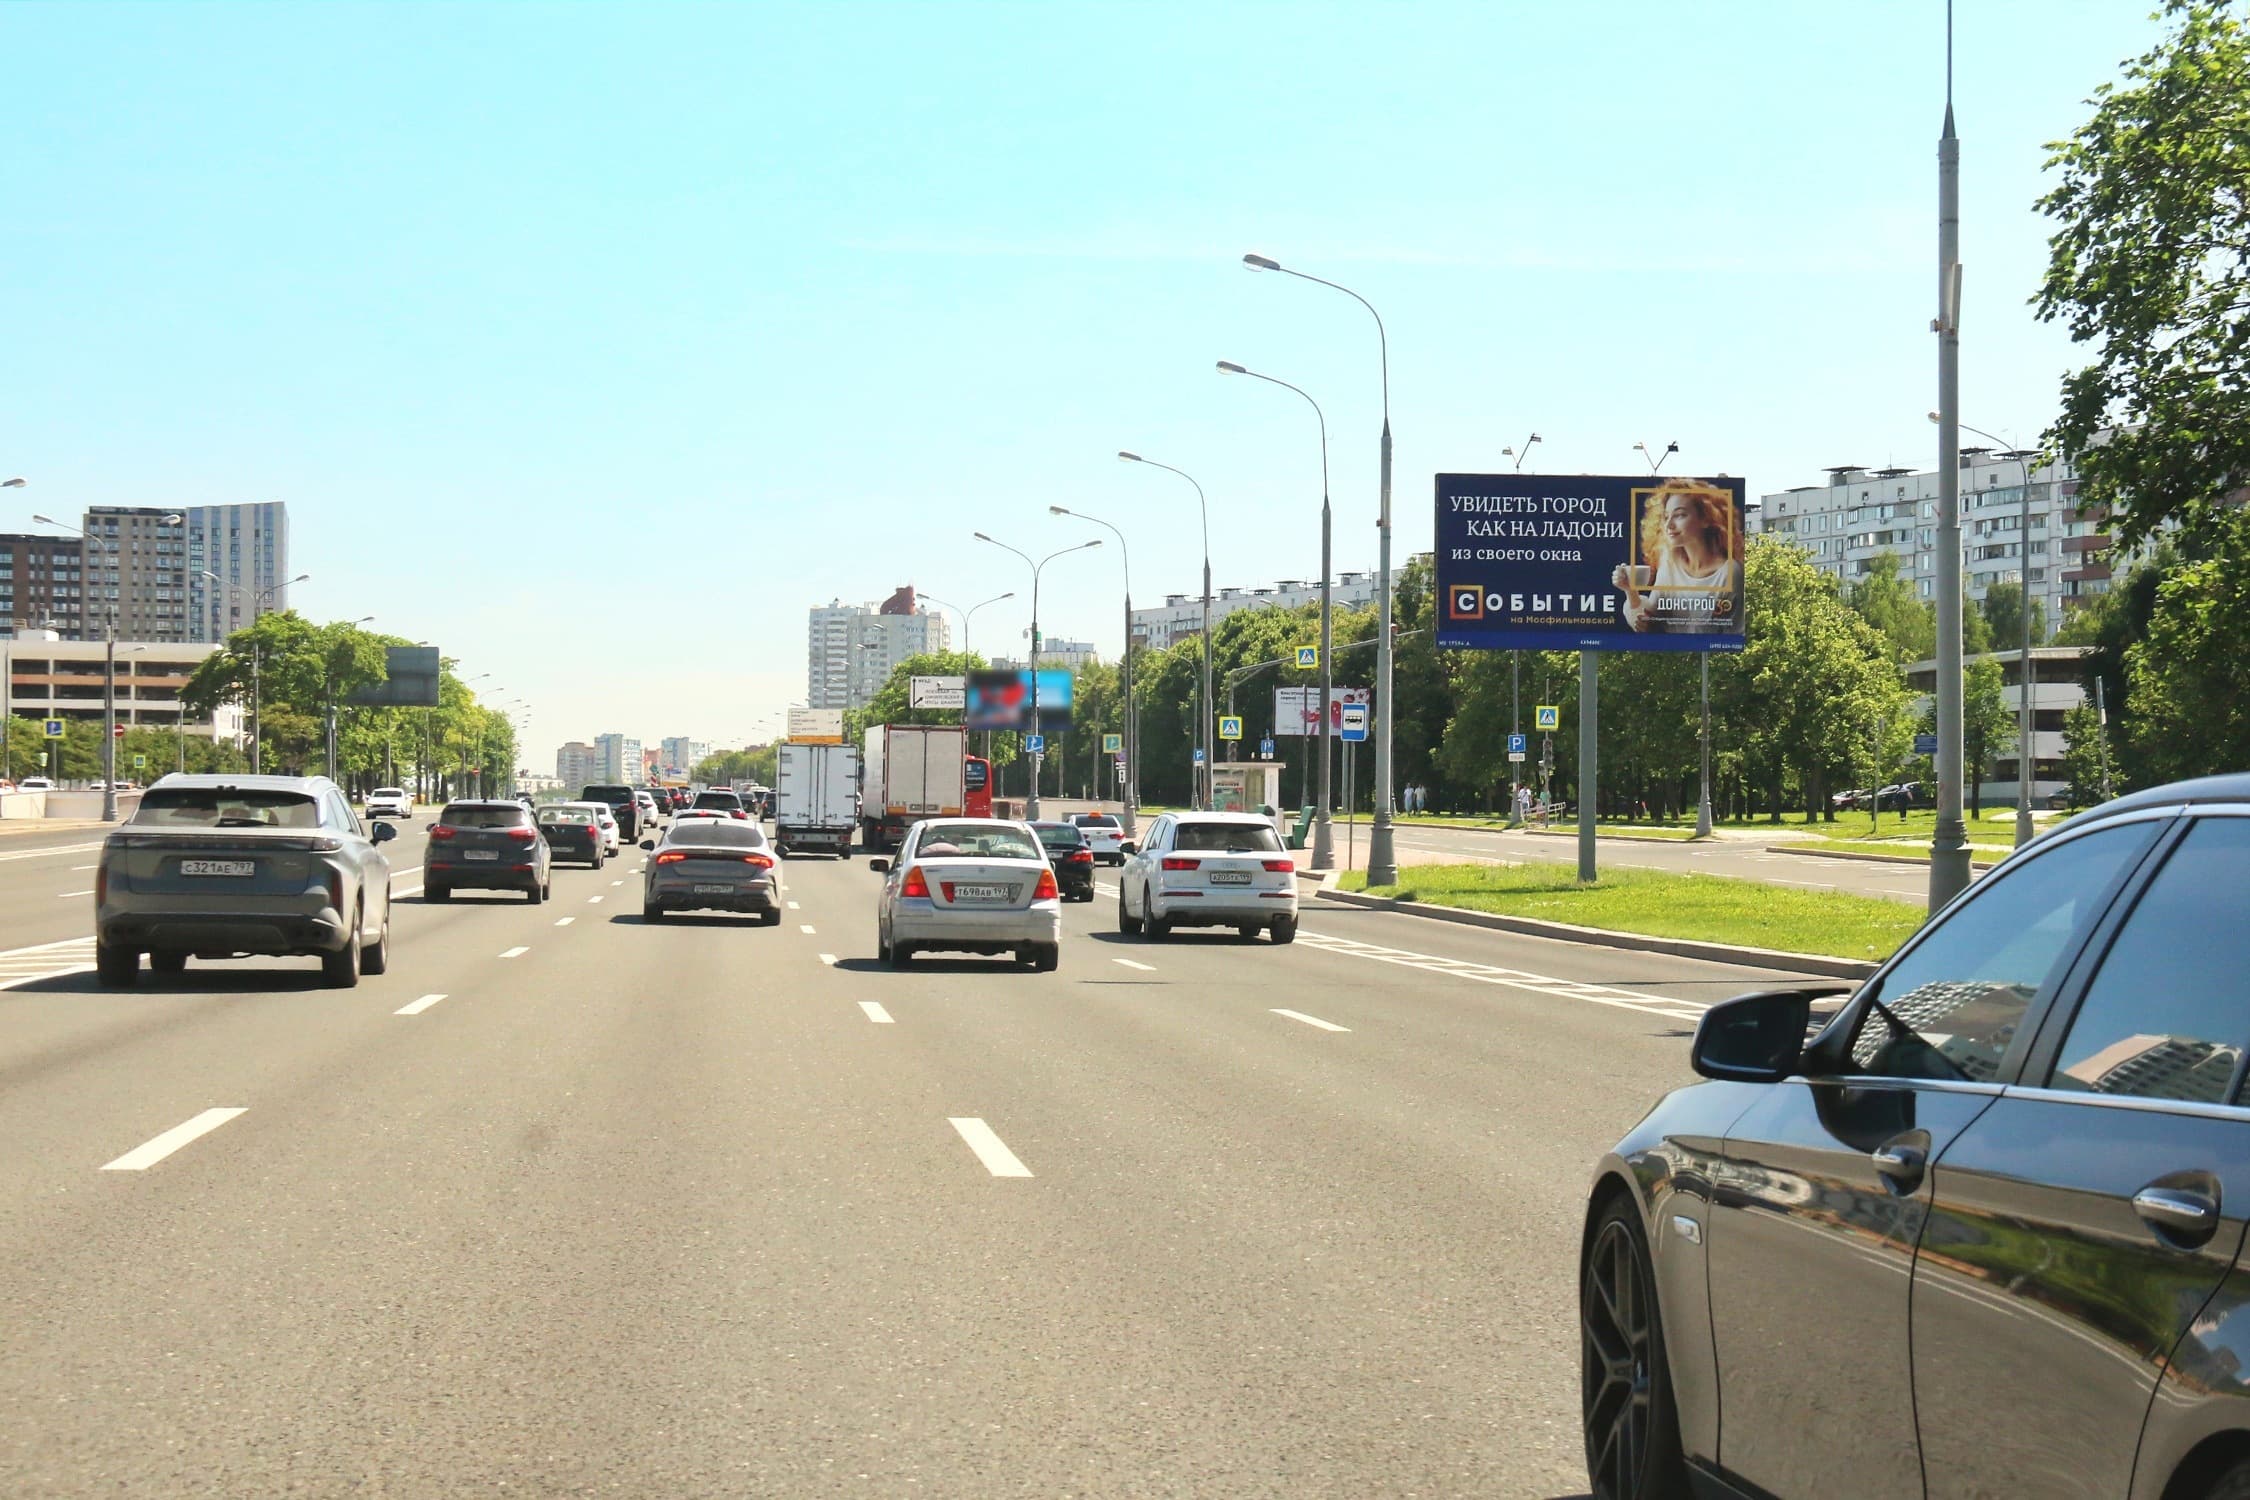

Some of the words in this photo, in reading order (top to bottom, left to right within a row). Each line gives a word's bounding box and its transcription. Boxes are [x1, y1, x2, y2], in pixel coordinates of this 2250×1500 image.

[1450, 496, 1538, 515] УВИДЕТЬ
[1542, 498, 1607, 517] ГОРОД
[1466, 520, 1506, 536] КАК
[1510, 521, 1538, 537] НА
[1541, 521, 1624, 541] ЛАДОНИ
[1451, 548, 1472, 560] из
[1476, 549, 1535, 561] своего
[1540, 550, 1583, 562] окна
[1458, 593, 1616, 612] СОБЫТИЕ
[1657, 595, 1716, 611] ДОНСТРОЙ
[1510, 616, 1524, 624] на
[1526, 615, 1615, 625] Мосфильмовской
